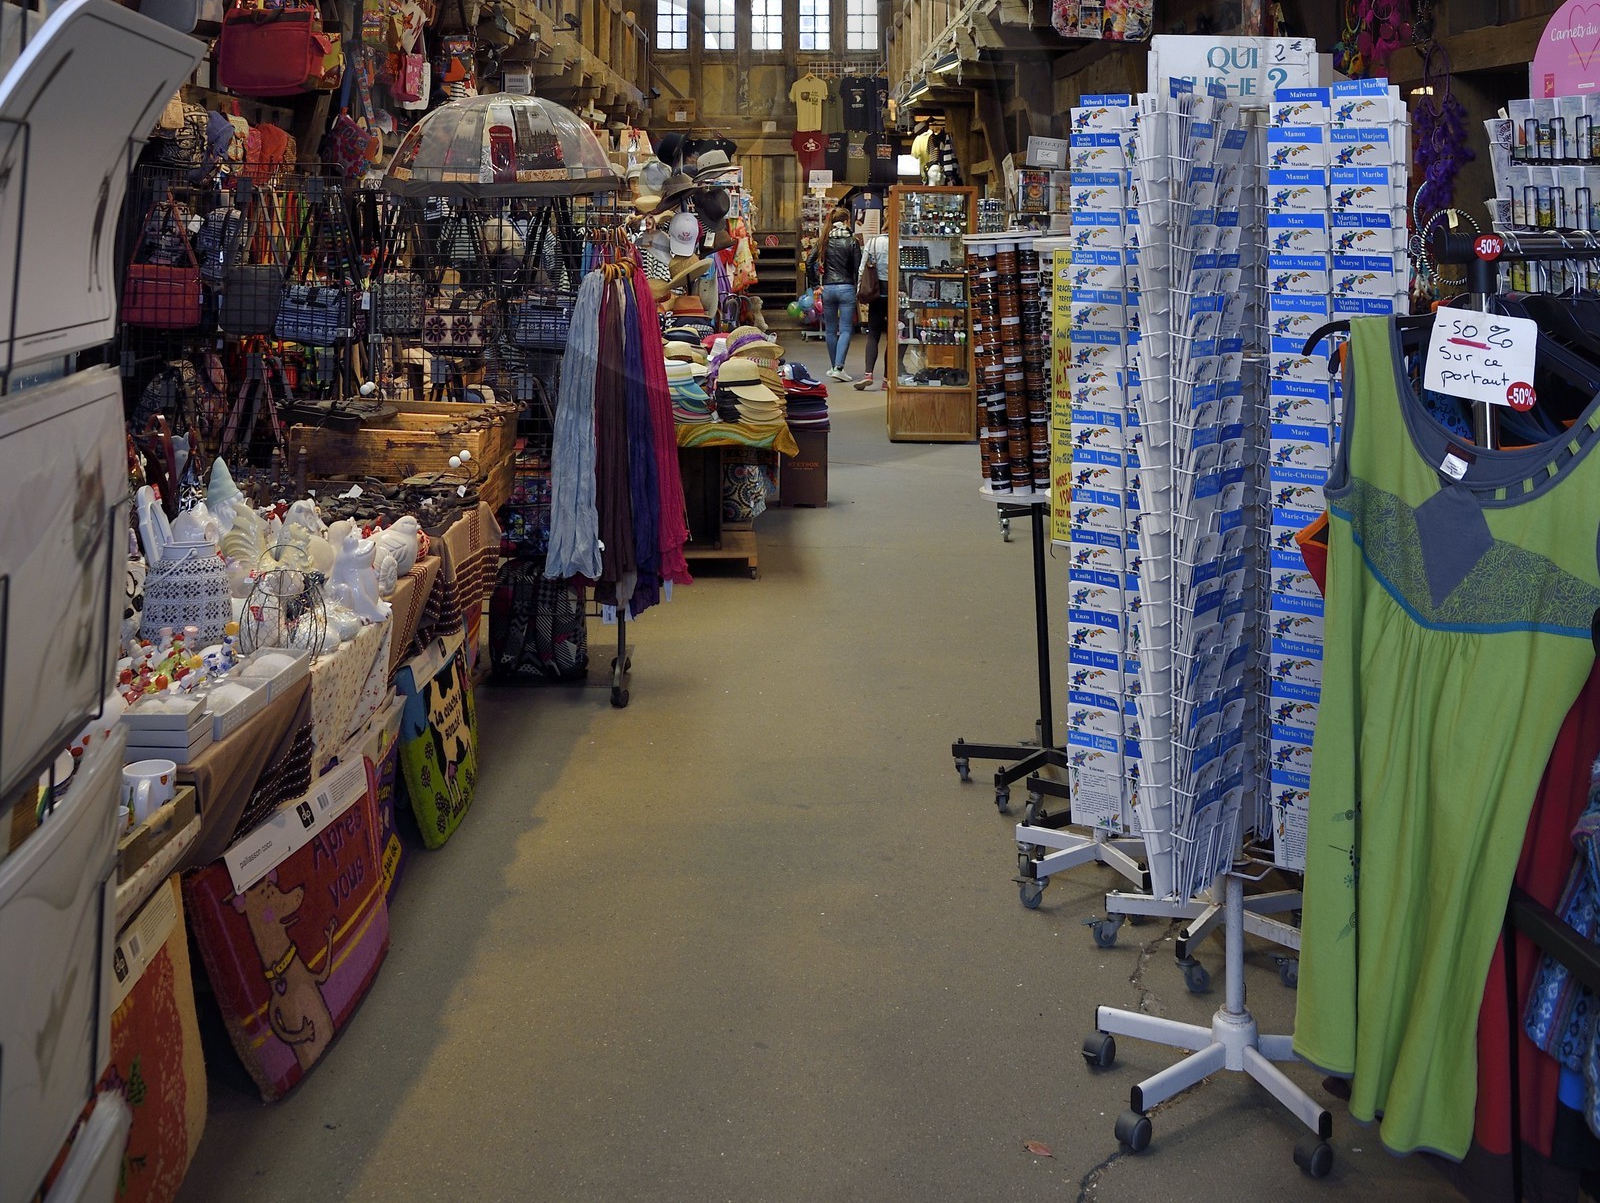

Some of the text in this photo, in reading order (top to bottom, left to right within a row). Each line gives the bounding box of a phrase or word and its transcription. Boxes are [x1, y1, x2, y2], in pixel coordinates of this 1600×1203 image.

[1550, 22, 1598, 42] Carnets du
[1207, 46, 1257, 74] QUI
[1181, 76, 1256, 97] U-JE
[1362, 81, 1386, 89] Marion
[1362, 132, 1385, 141] Marjorie
[1476, 239, 1501, 254] -50%
[1100, 254, 1117, 262] Dylan
[1297, 259, 1322, 267] Marcelle
[1339, 259, 1360, 267] Maryse
[1274, 298, 1295, 306] Margot
[1299, 299, 1325, 307] Margaux
[1367, 301, 1389, 309] Mathias
[1439, 345, 1503, 367] Sur ce
[1285, 384, 1316, 394] Marianne
[1508, 386, 1534, 405] -50%
[1290, 428, 1310, 437] Marie
[1079, 452, 1091, 460] Ella
[1101, 454, 1118, 463] Elodie
[1274, 469, 1325, 480] Marie-Christine
[1280, 511, 1318, 521] Marie-Clair
[1075, 533, 1094, 541] Emma
[1280, 597, 1323, 609] Marie-Hélène
[1100, 615, 1113, 623] Eric
[1280, 641, 1321, 655] Marie-Laure
[1072, 652, 1090, 661] Erwan
[1096, 655, 1115, 664] Esteban
[1280, 684, 1321, 697] Marie-Pierre
[1099, 699, 1116, 707] Ethan
[1070, 733, 1090, 742] Etienne
[239, 848, 262, 870] paillasson
[328, 855, 365, 910] vous
